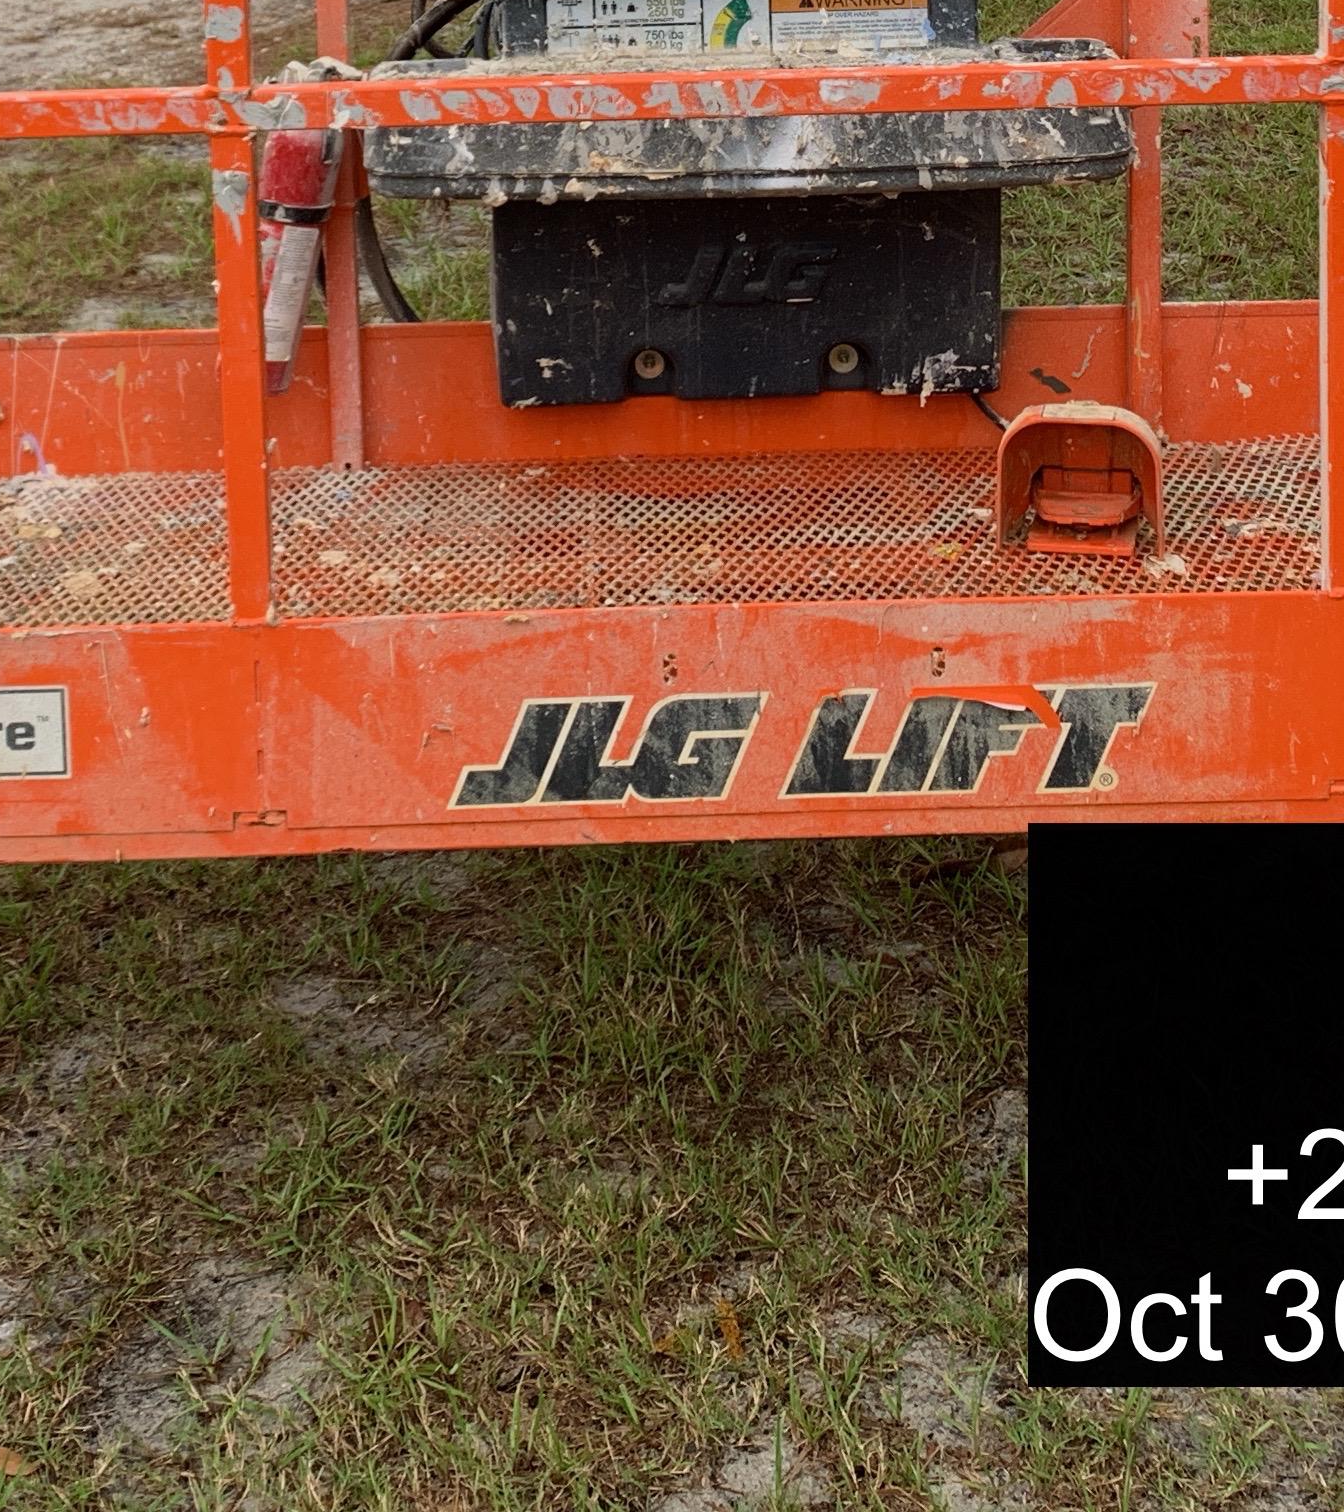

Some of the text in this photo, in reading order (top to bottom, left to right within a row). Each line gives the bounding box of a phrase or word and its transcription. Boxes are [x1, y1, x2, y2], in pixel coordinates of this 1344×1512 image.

[647, 6, 685, 18] 250 kg
[645, 29, 684, 40] 750 lbs
[670, 40, 683, 51] kg
[657, 242, 838, 308] JLG
[447, 683, 1157, 809] JLG LIFT
